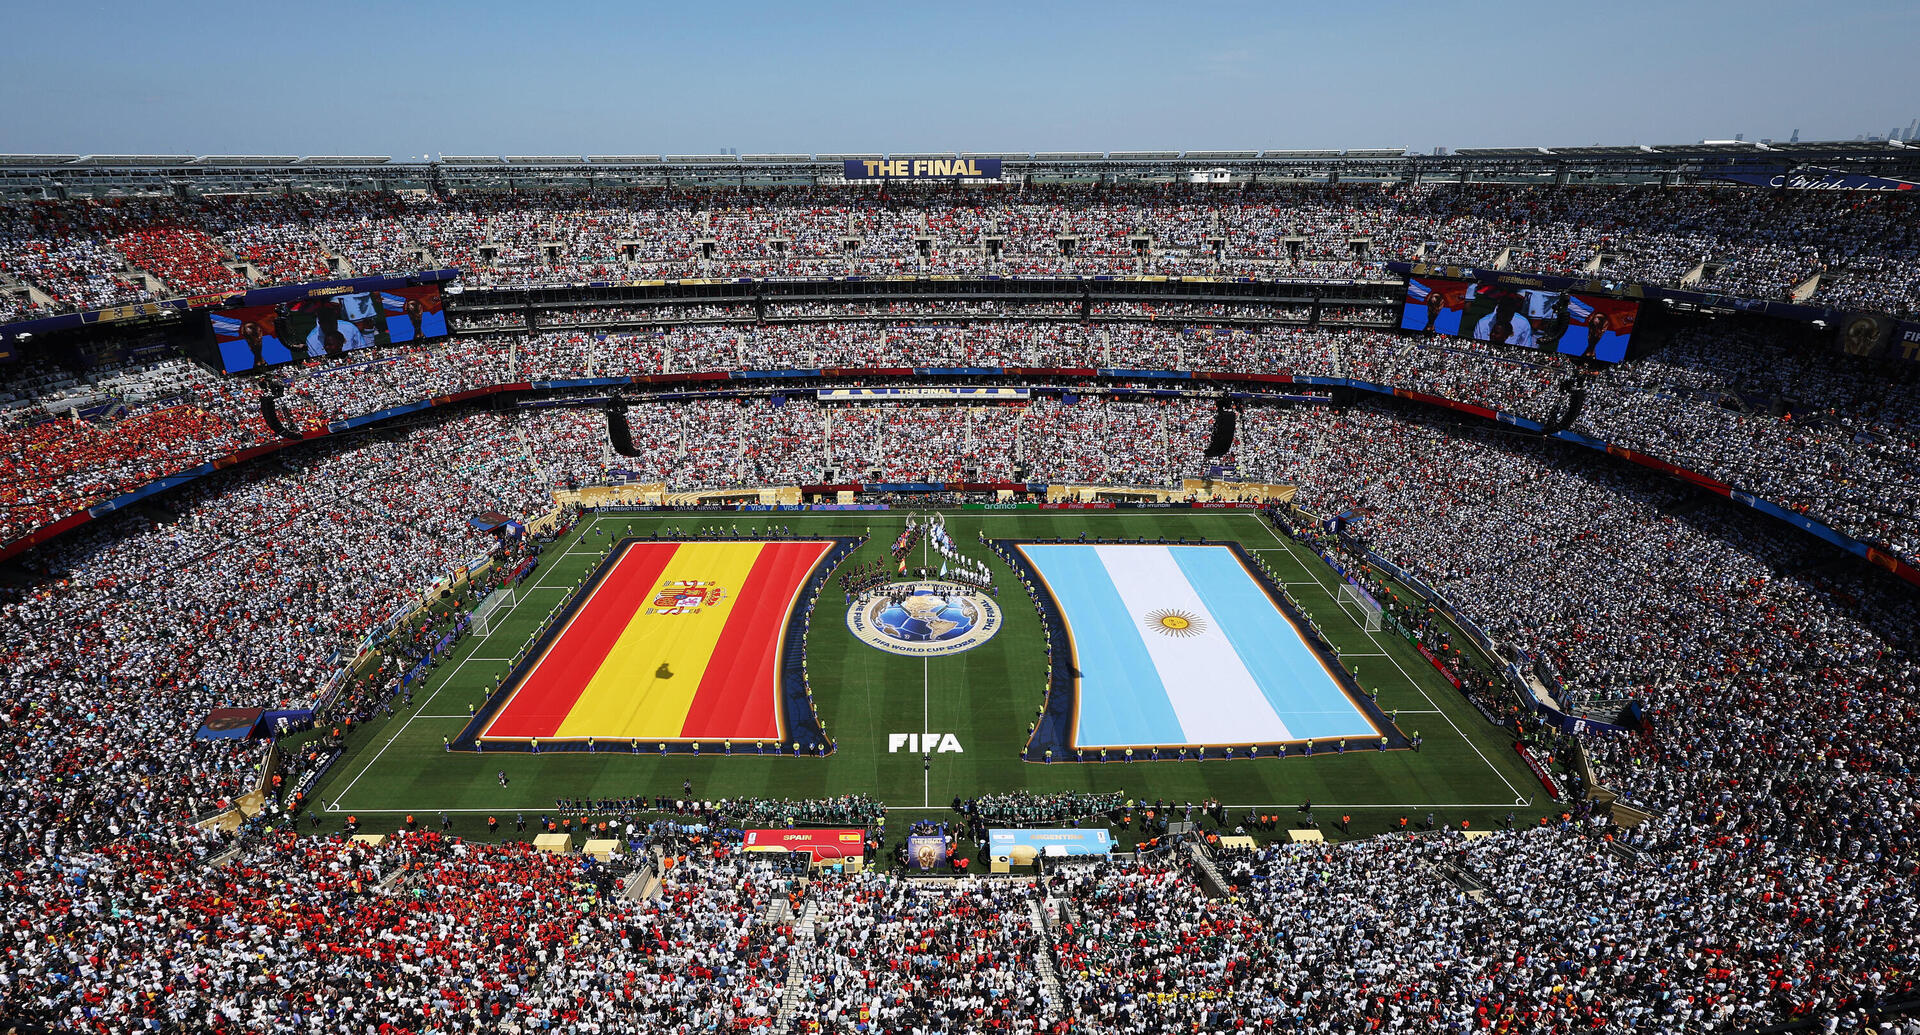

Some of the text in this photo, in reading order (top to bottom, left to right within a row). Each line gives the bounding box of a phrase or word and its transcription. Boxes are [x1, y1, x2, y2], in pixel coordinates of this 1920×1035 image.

[863, 159, 983, 177] THE FINAL
[308, 285, 355, 297] #FIFAWorldCup
[1498, 276, 1544, 288] #FIFAWorldCup
[853, 612, 865, 632] FINAL
[982, 599, 995, 631] THE FINAL
[872, 637, 890, 648] FIFA
[891, 644, 925, 653] WORLD
[947, 638, 976, 650] 2026
[888, 733, 964, 753] FIFA
[1522, 749, 1544, 780] Lenovo
